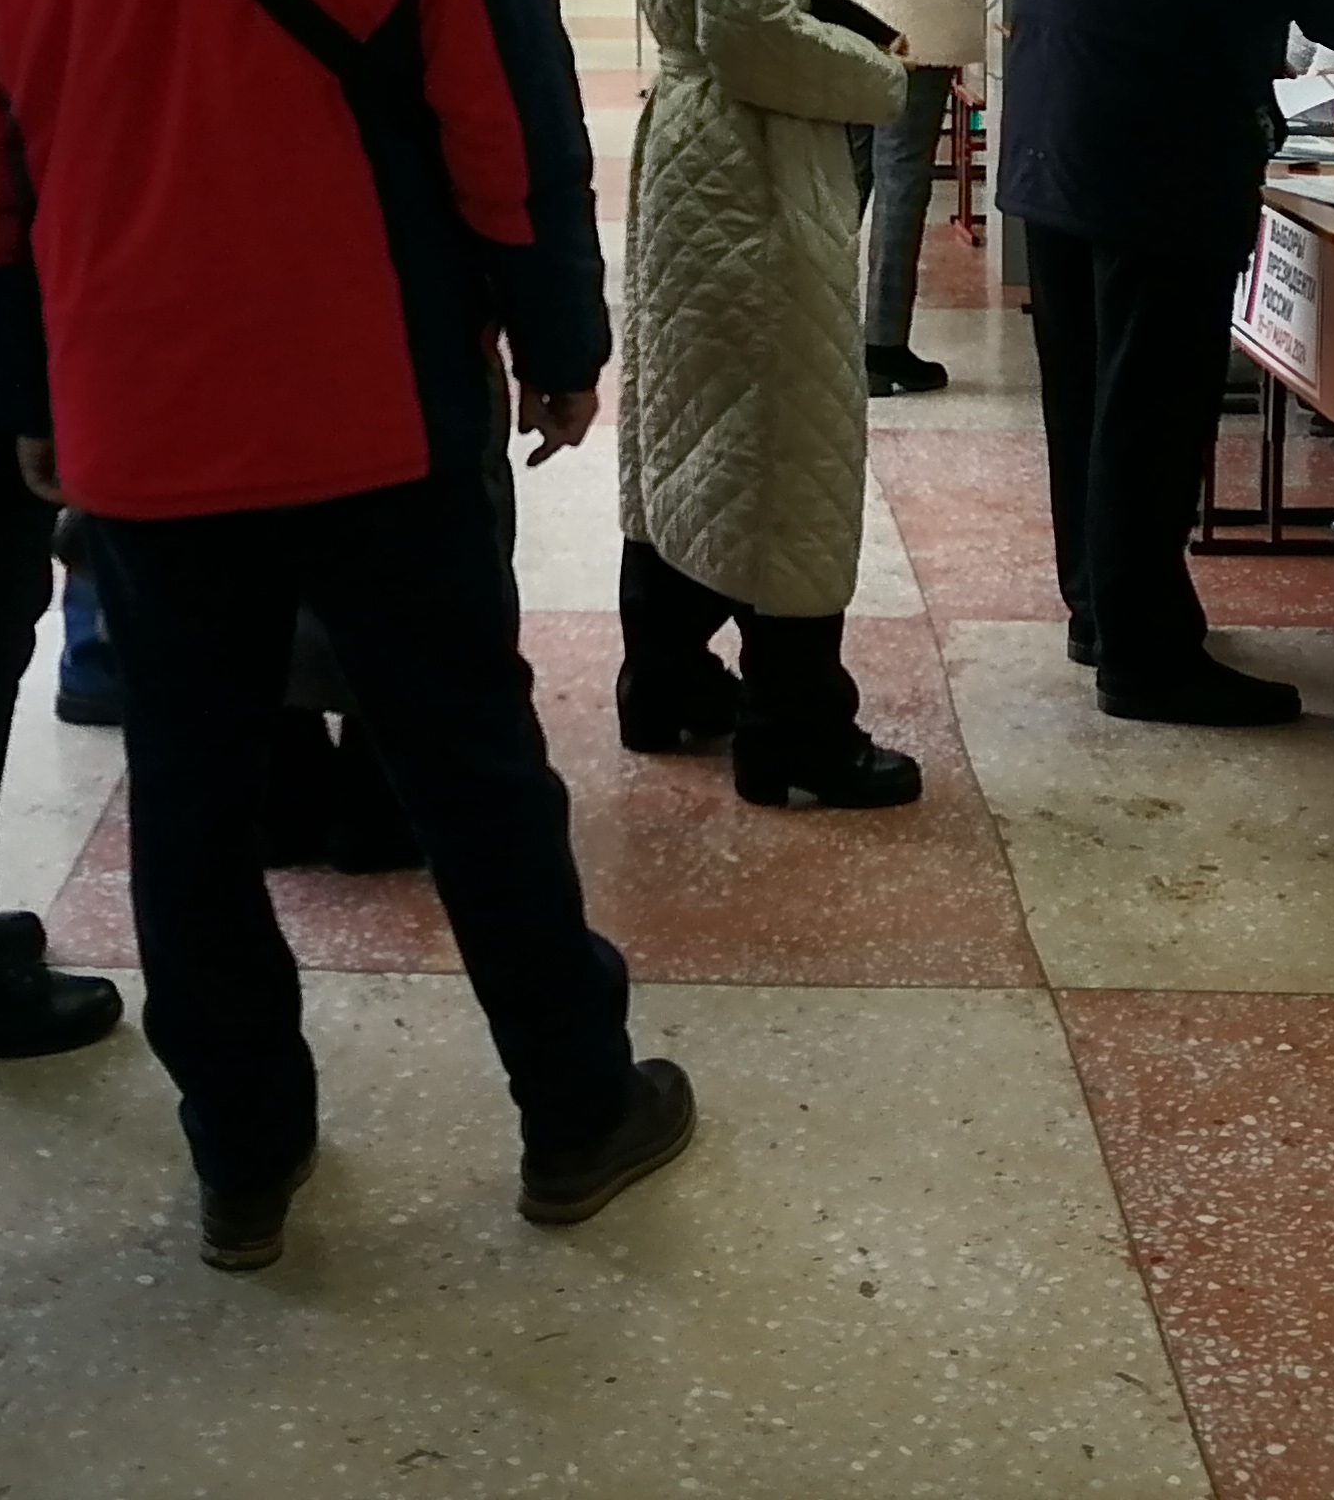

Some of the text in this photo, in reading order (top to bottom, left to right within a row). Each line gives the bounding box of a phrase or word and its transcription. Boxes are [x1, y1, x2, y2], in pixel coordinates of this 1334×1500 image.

[1270, 219, 1307, 259] ВЫБОРЫ
[1267, 251, 1316, 302] ПРЕЗИДЕНТА
[1262, 282, 1294, 322] РОССИИ
